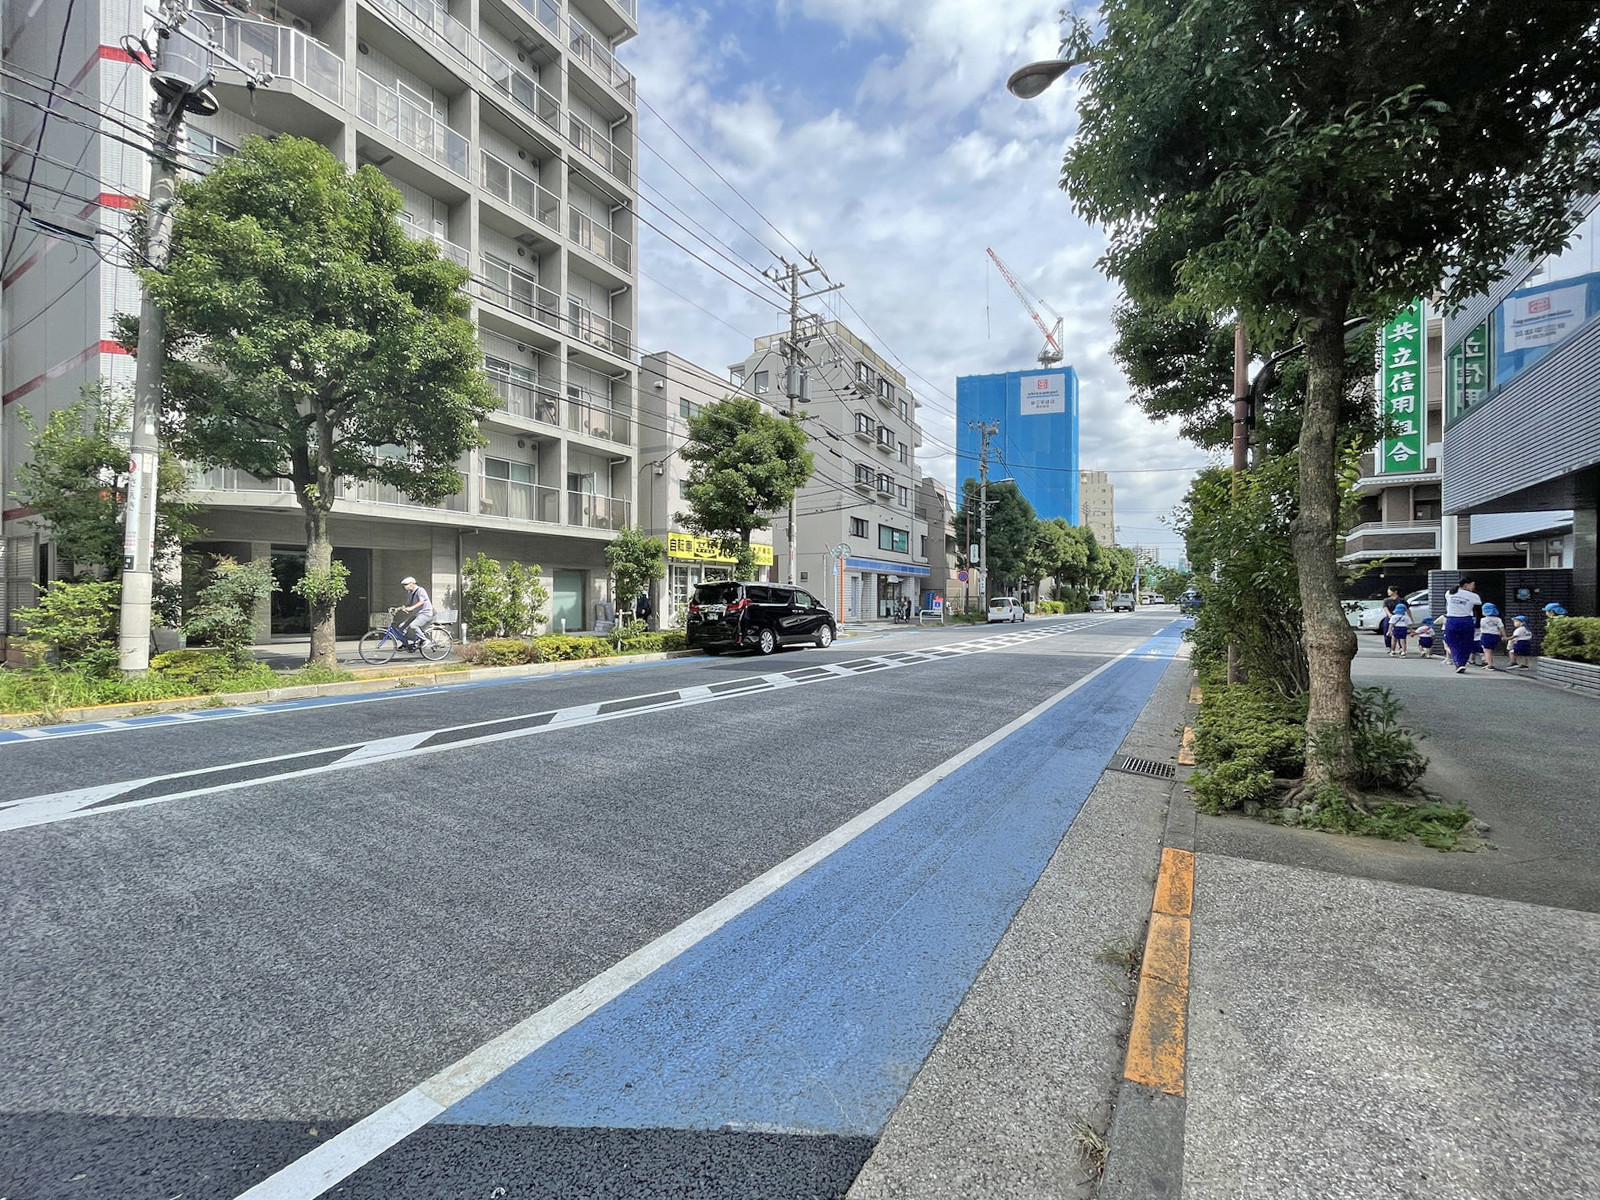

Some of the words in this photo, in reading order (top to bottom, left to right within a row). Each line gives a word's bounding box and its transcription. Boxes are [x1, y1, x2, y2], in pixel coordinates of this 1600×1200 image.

[1387, 302, 1419, 462] 共立信用組合
[670, 538, 693, 552] 自転車
